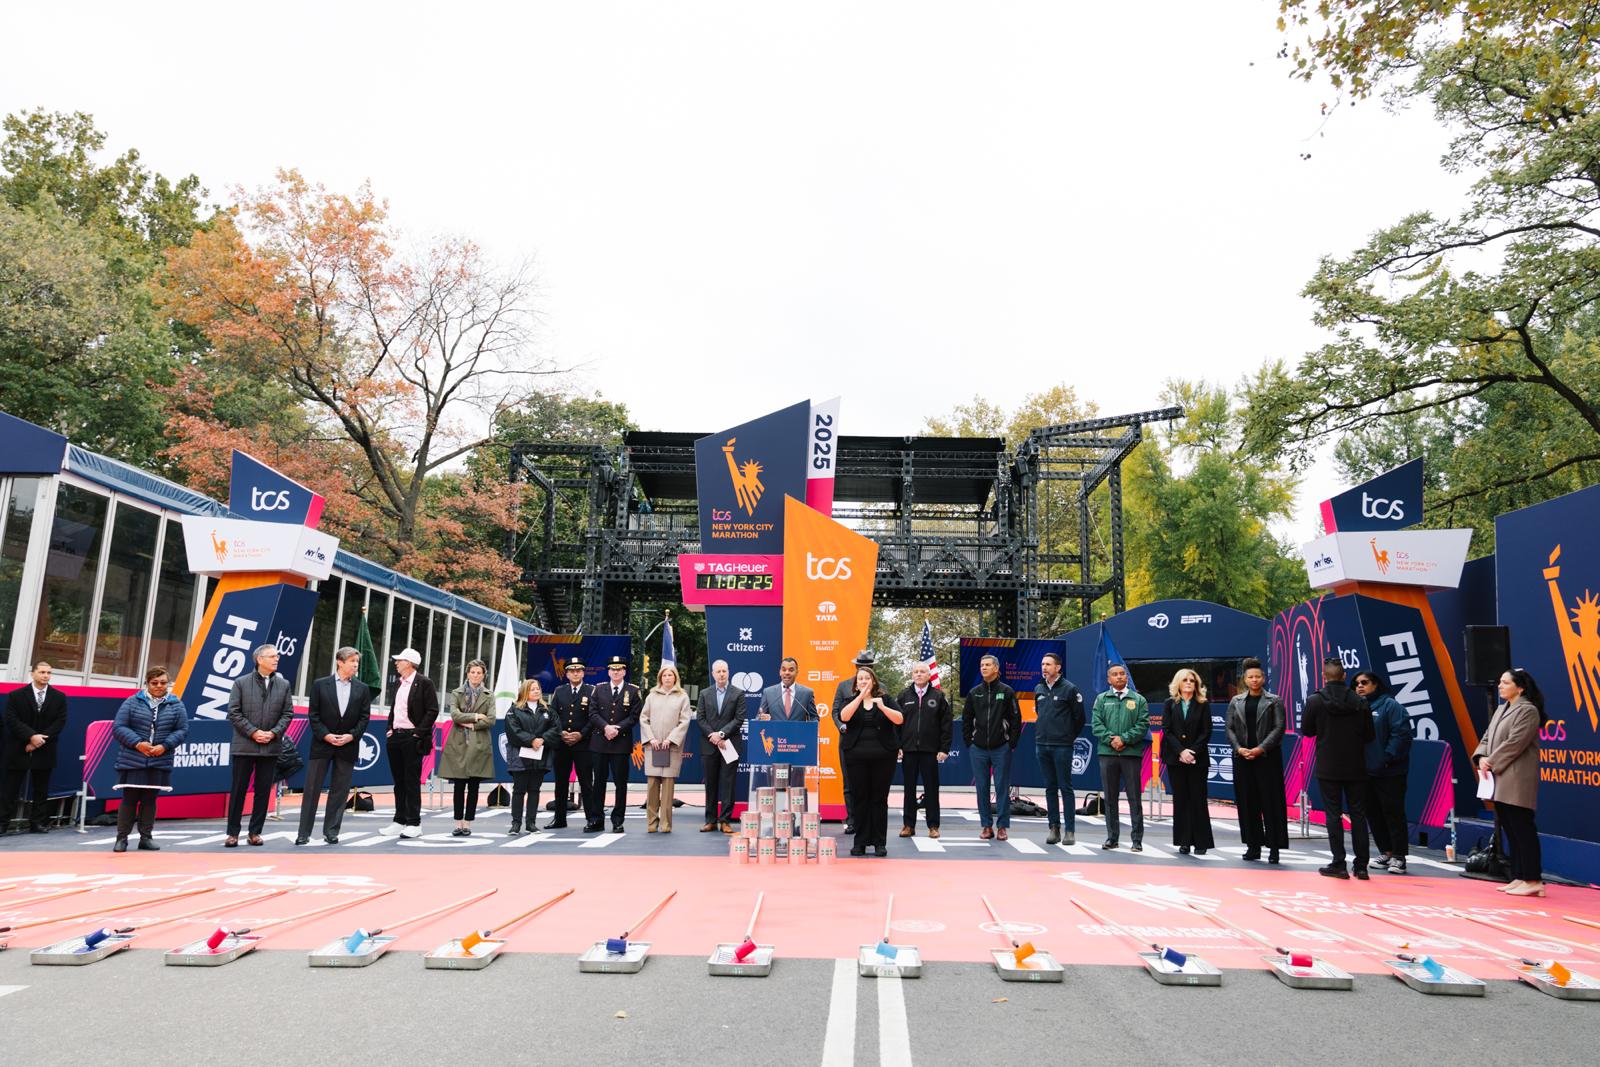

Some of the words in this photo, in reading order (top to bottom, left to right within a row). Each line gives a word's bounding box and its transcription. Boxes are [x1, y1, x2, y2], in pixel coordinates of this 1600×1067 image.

[813, 414, 833, 470] 2025
[251, 486, 290, 511] tcs
[1361, 491, 1404, 520] tcs
[712, 508, 732, 521] tcs
[755, 523, 774, 531] CITY
[712, 531, 759, 539] MARATHON
[806, 552, 852, 580] tcs
[1180, 614, 1212, 625] ESPN
[276, 630, 297, 656] tcs
[726, 642, 763, 652] Citizens
[1338, 646, 1361, 669] tcs
[194, 614, 259, 720] NISH
[189, 743, 220, 755] PARK
[1539, 748, 1567, 763] NEW
[173, 755, 220, 767] RVANCY
